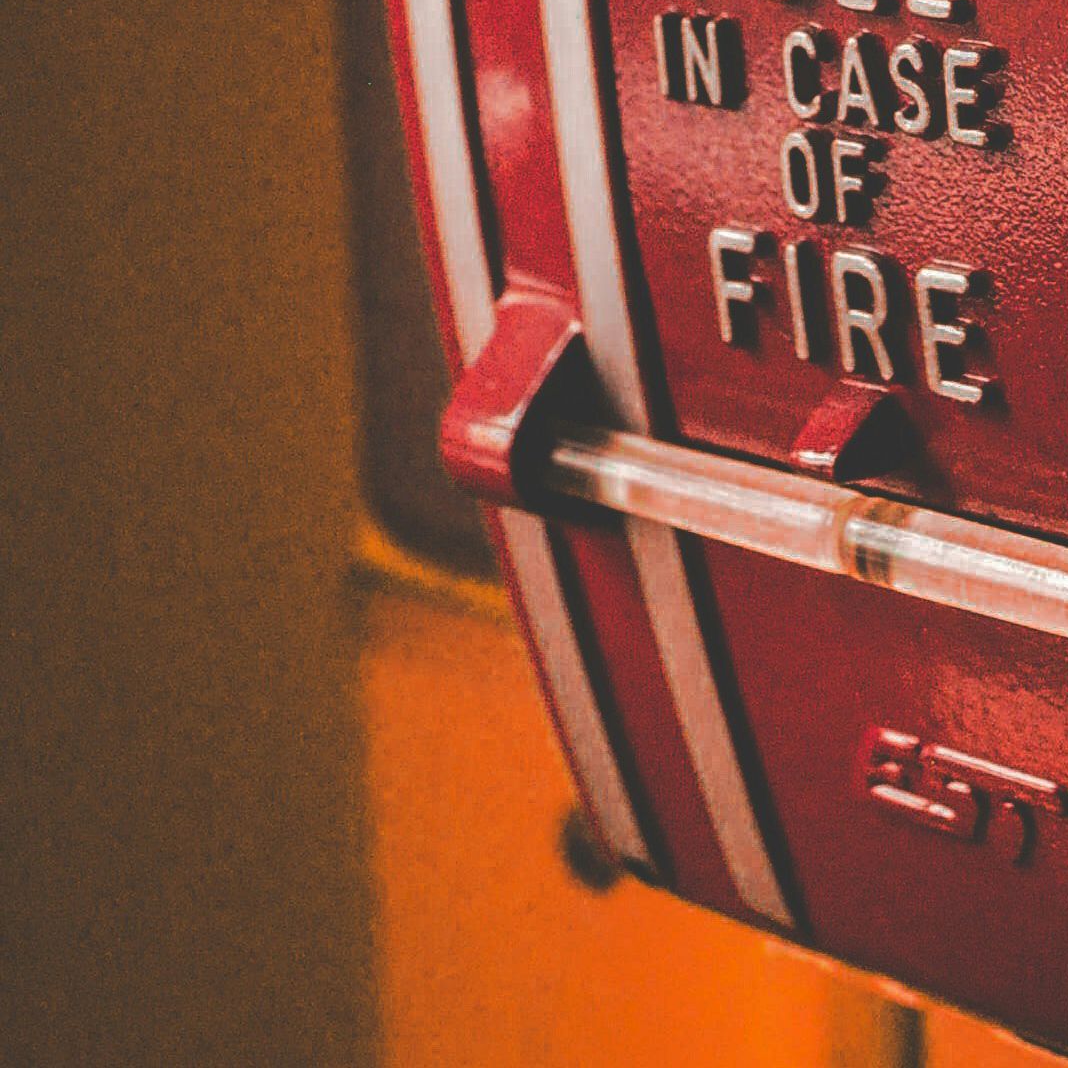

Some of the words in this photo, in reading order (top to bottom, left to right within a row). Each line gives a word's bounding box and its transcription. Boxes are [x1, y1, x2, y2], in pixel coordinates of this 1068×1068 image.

[653, 12, 724, 108] IN
[781, 28, 990, 148] CASE
[779, 130, 868, 224] OF
[709, 228, 984, 405] FIRE
